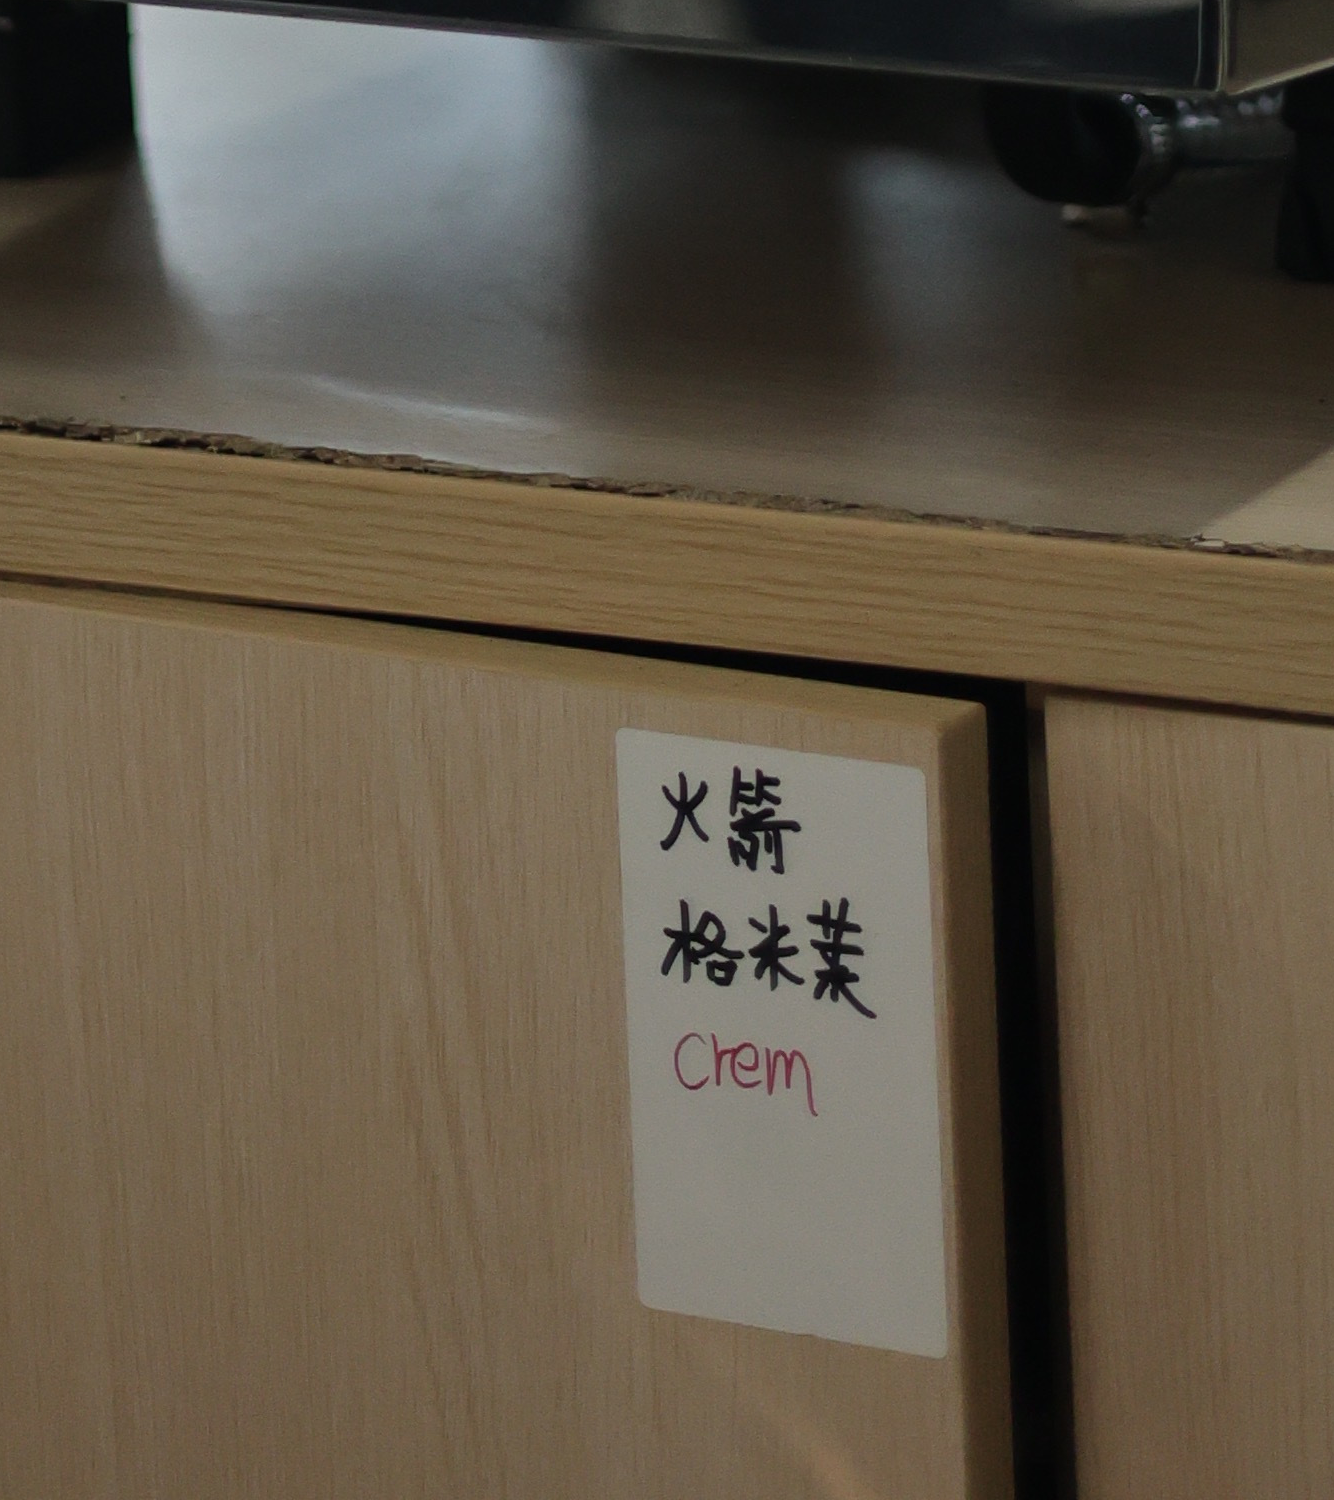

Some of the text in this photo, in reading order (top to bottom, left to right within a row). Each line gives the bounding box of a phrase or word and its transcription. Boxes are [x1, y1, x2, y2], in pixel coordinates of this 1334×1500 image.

[660, 766, 801, 876] 火箭
[661, 897, 878, 1020] 格米莱
[673, 1031, 818, 1118] Crem
